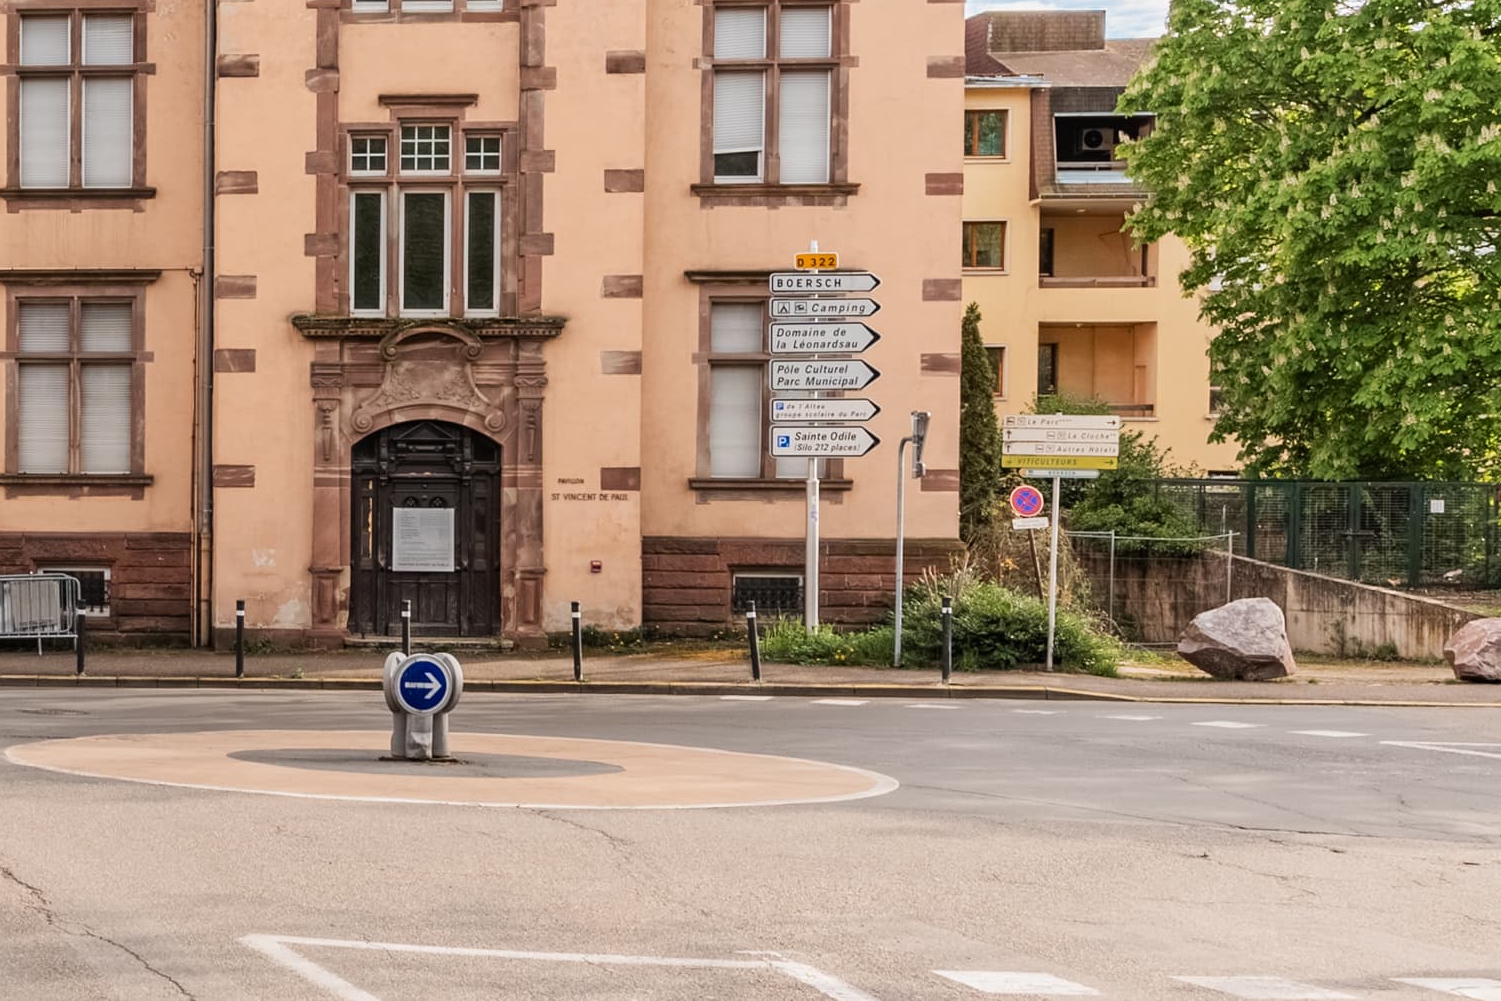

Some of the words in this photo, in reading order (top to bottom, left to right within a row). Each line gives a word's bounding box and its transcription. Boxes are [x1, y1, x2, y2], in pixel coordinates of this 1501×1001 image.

[796, 258, 805, 267] D
[810, 257, 836, 267] 322
[776, 278, 842, 288] BOERSCH
[811, 302, 866, 315] Camping
[776, 327, 827, 338] Domaine
[832, 327, 847, 337] de
[776, 339, 787, 349] la
[792, 339, 859, 349] Léonardsau
[777, 364, 800, 375] Pôle
[804, 364, 849, 375] Culturel
[777, 376, 801, 386] Parc
[805, 376, 859, 388] Municipal
[795, 431, 827, 441] Sainte
[830, 431, 857, 441] Odile
[814, 443, 829, 452] 212
[1056, 445, 1085, 453] Autres
[1089, 444, 1116, 454] Hôtels
[1017, 458, 1078, 466] VITICULTEURS
[551, 493, 561, 501] ST
[563, 493, 597, 501] VINCENT
[599, 493, 609, 501] DE
[610, 493, 629, 501] PAUL
